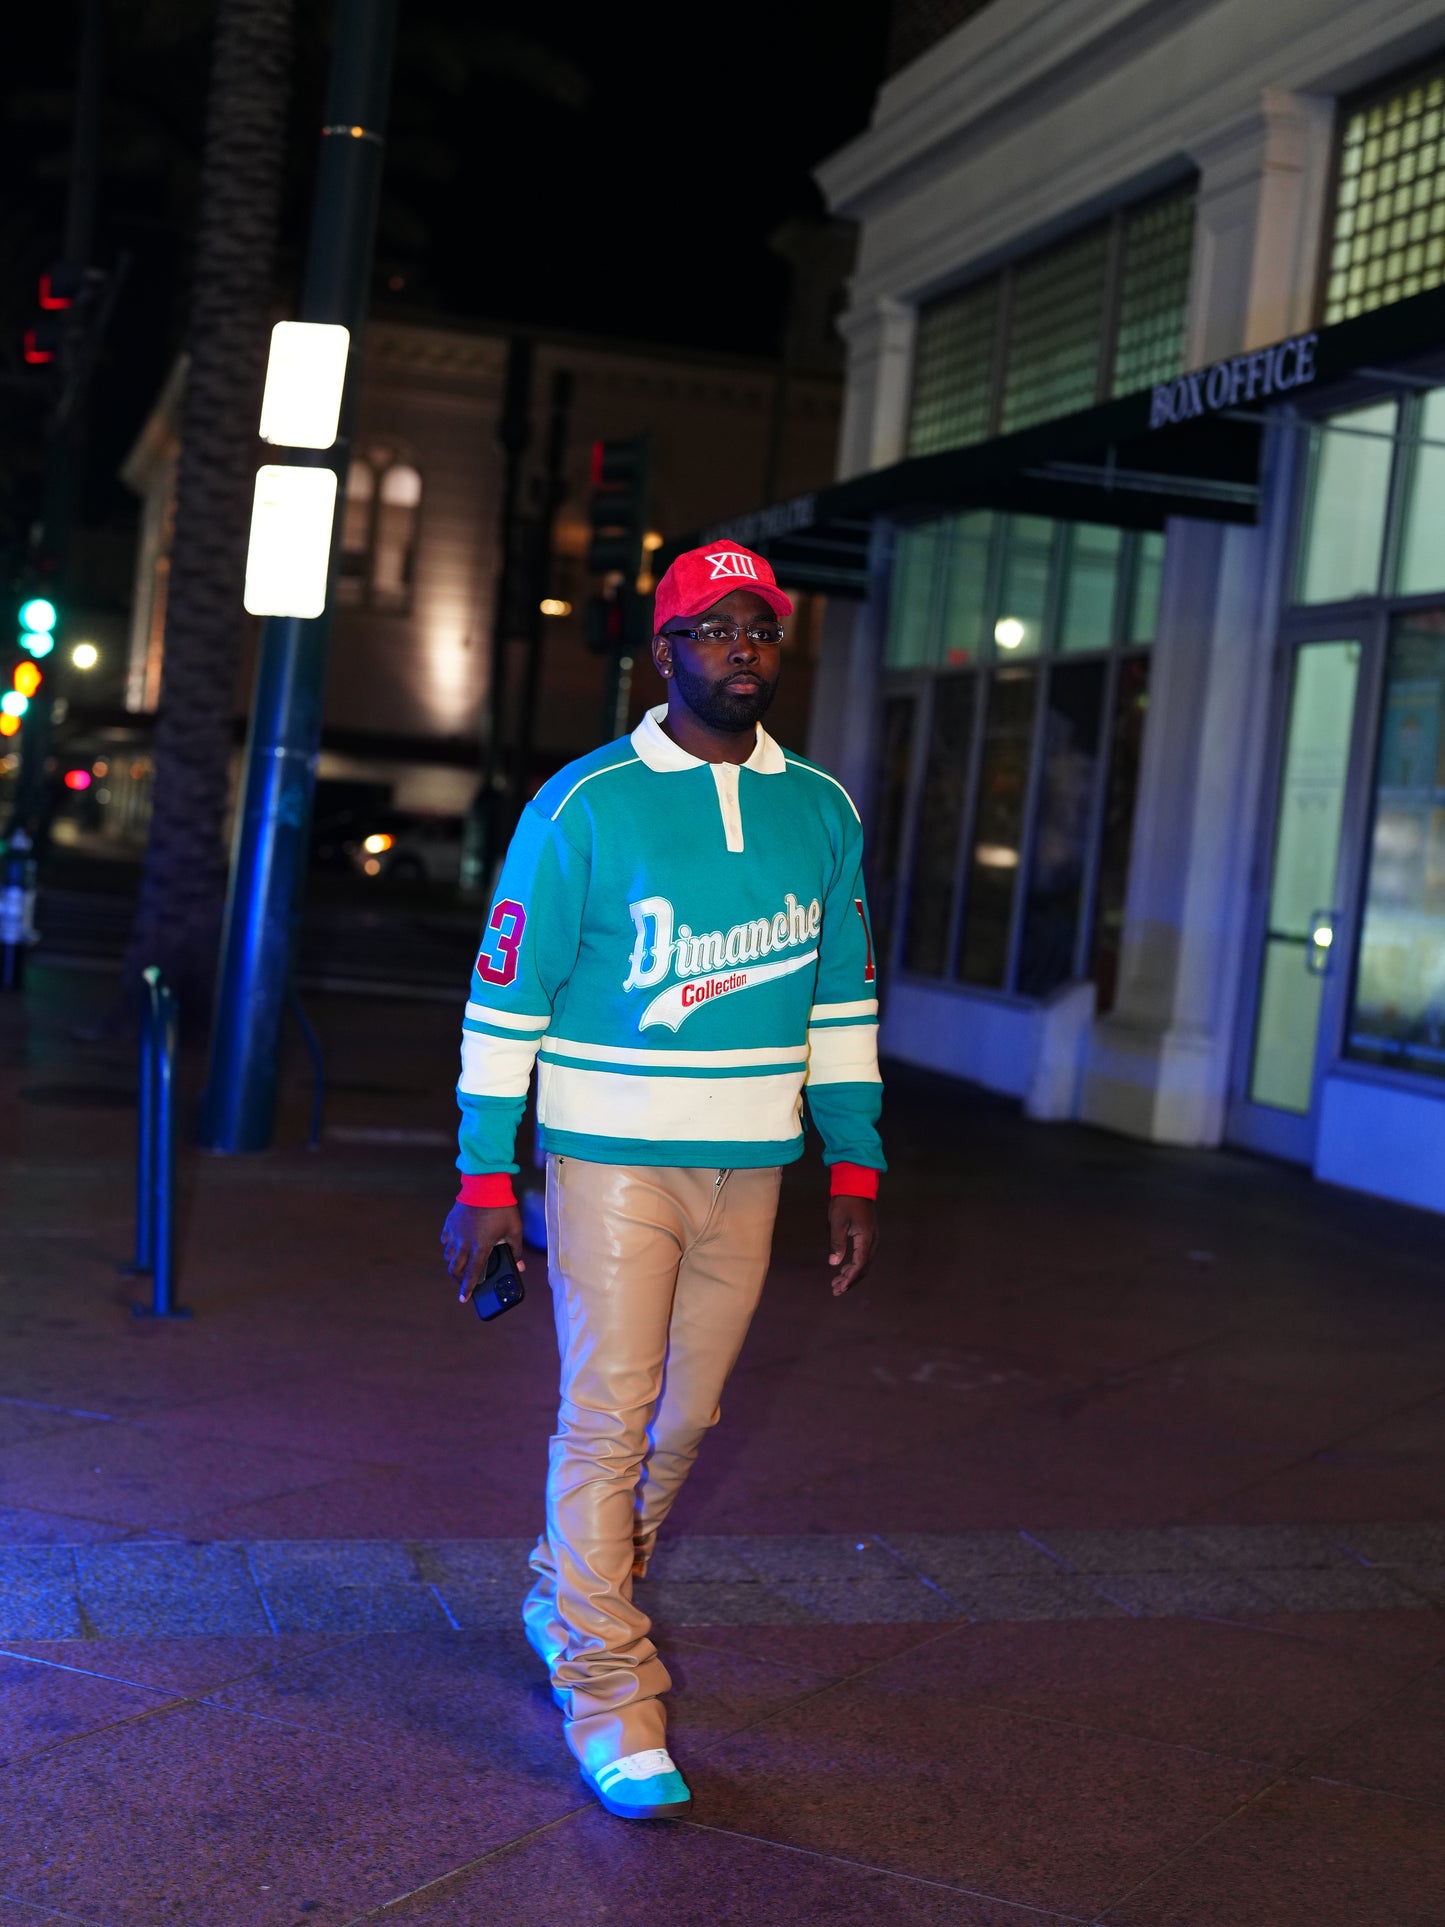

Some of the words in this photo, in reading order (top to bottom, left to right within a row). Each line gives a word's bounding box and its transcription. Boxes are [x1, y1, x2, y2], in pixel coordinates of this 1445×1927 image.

[1149, 371, 1206, 429] BOX
[1206, 333, 1319, 409] OFFICE
[704, 551, 759, 580] XIII
[475, 898, 527, 987] 3
[623, 893, 821, 992] Dimanche
[681, 973, 747, 1008] Collection
